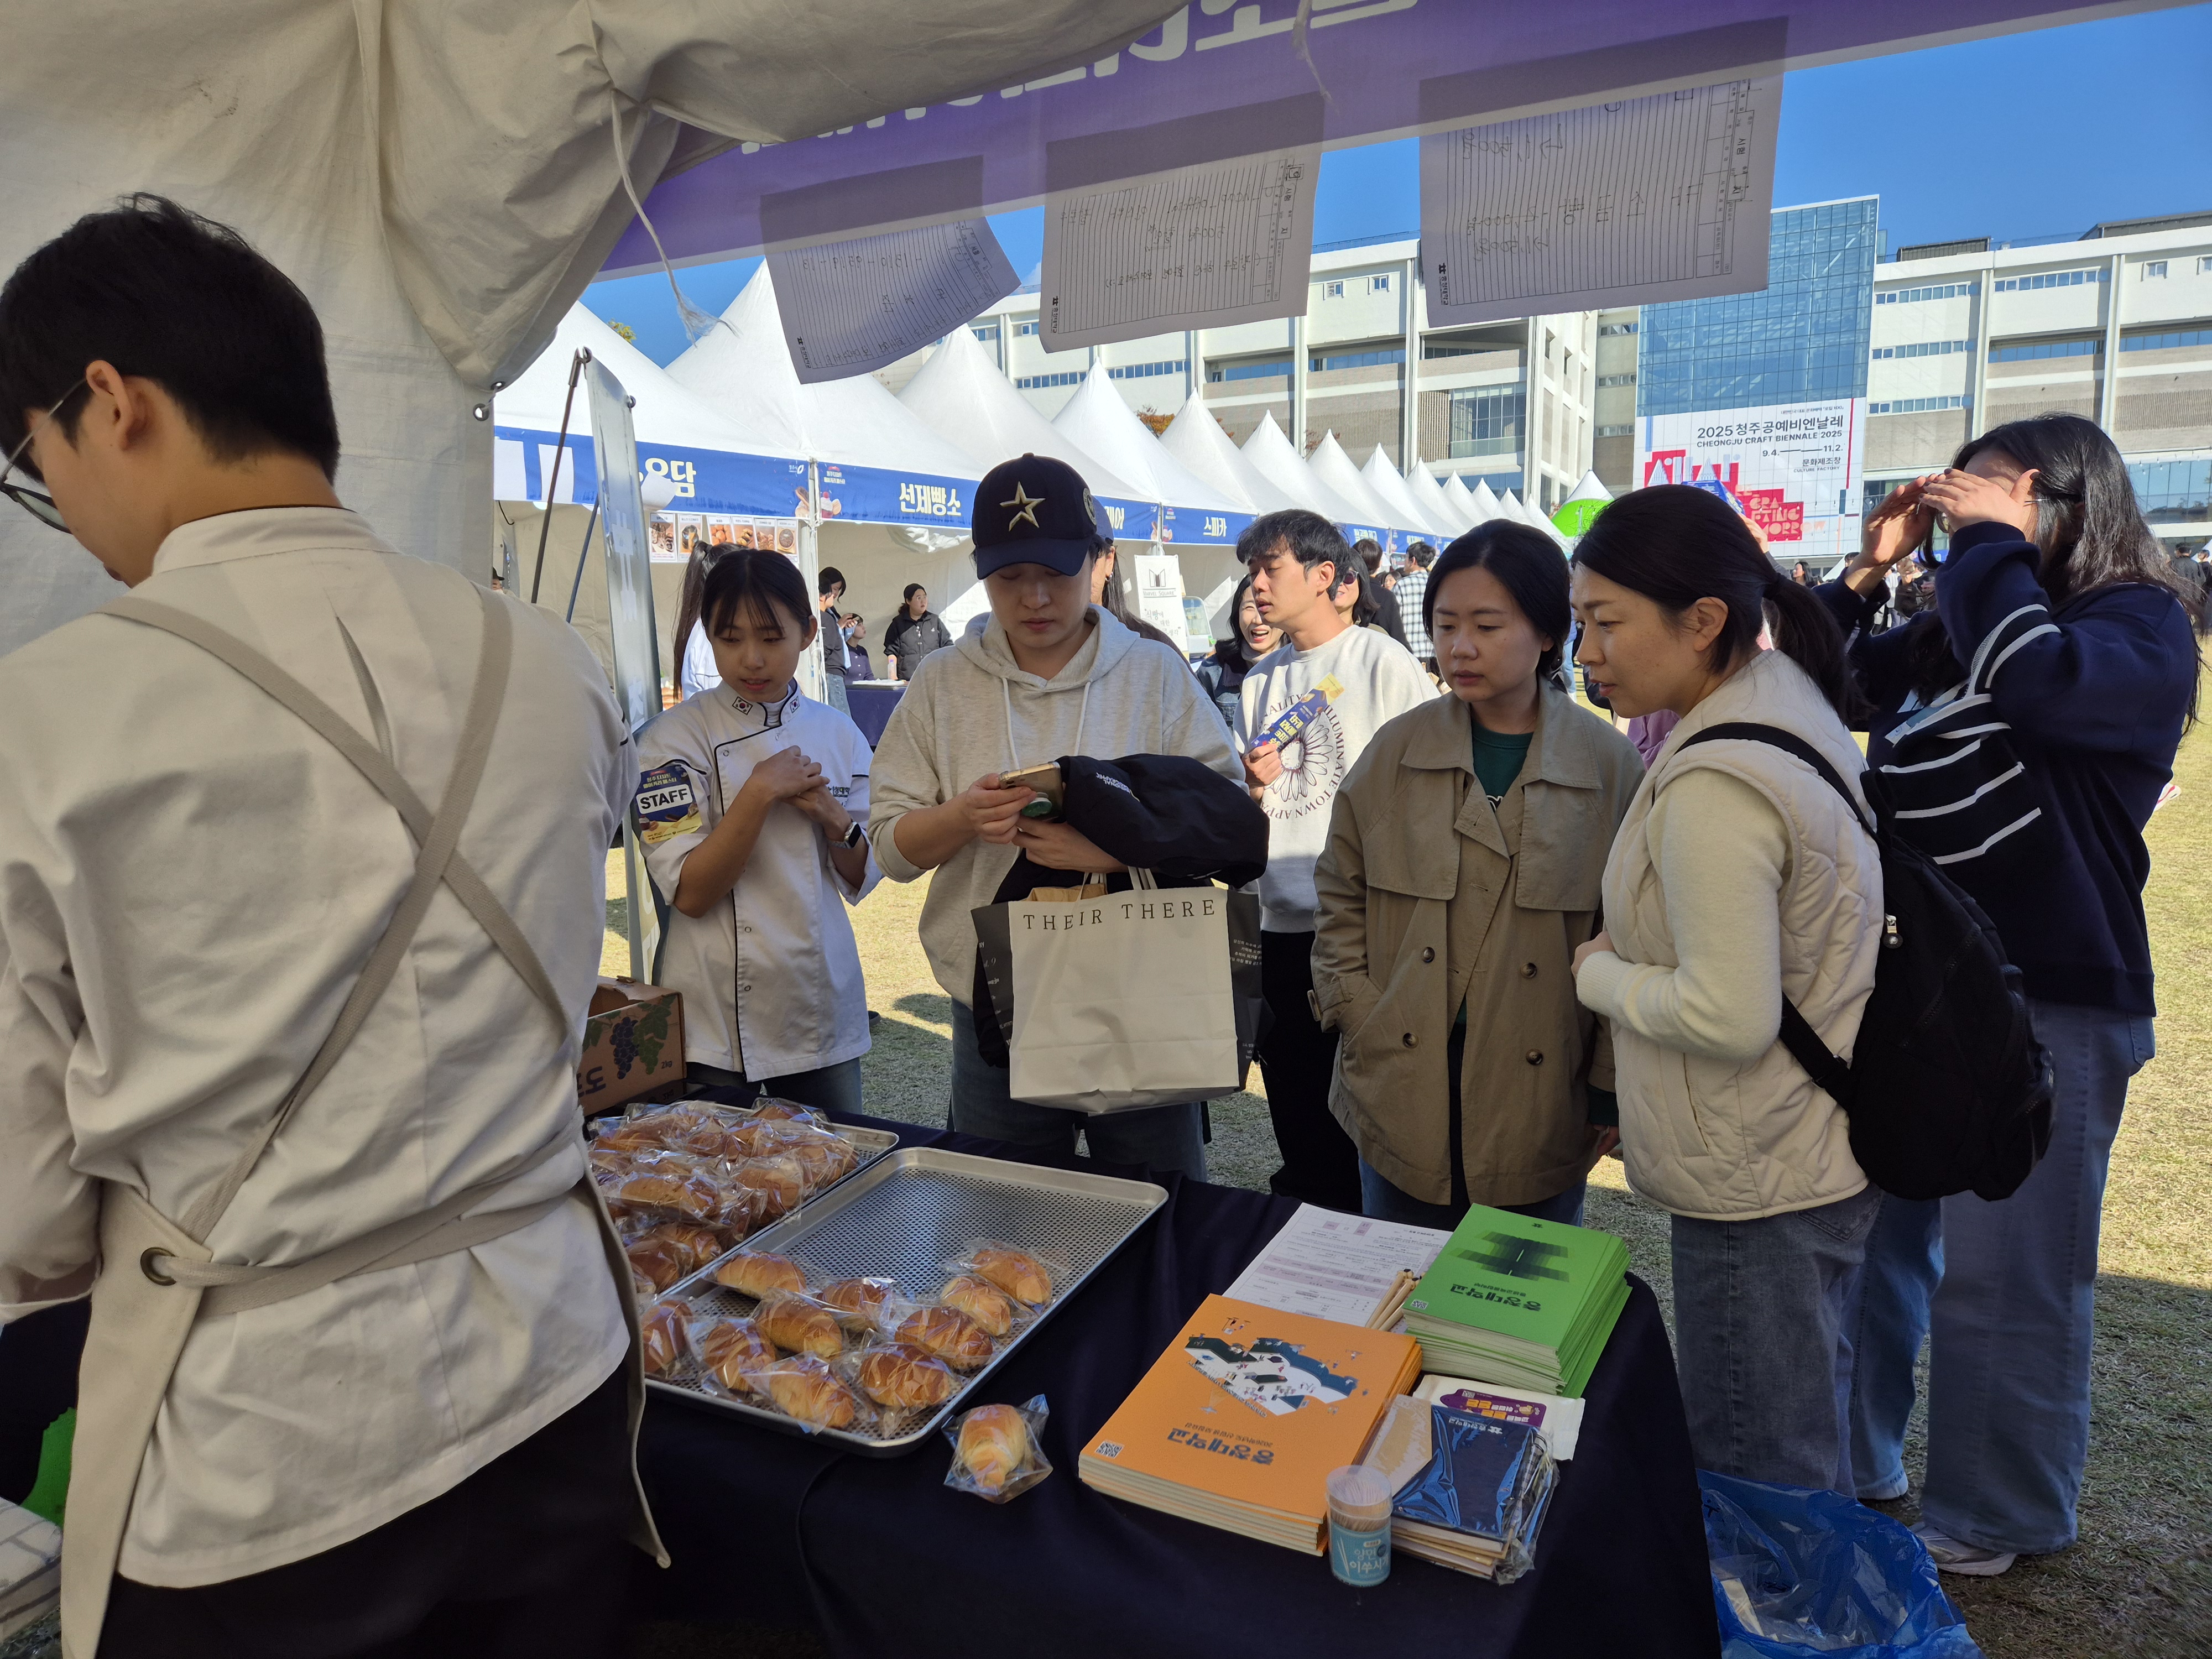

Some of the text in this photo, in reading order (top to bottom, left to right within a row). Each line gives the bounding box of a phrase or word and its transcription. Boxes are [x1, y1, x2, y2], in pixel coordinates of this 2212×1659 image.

[1697, 415, 1844, 439] 2025 청주공예비엔날레
[1697, 430, 1843, 447] CHEONGJU CRAFT BIENNALE 2025
[1802, 457, 1841, 467] 문화제조창
[899, 482, 962, 516] 선제빵소
[1203, 516, 1227, 537] 스피카
[640, 788, 688, 810] STAFF
[1295, 787, 1333, 819] TOWN
[1023, 899, 1215, 930] THEIR THERE
[661, 1060, 672, 1070] 2kg
[1450, 1284, 1542, 1312] 충청대학교
[1167, 1427, 1275, 1465] 충청대학교
